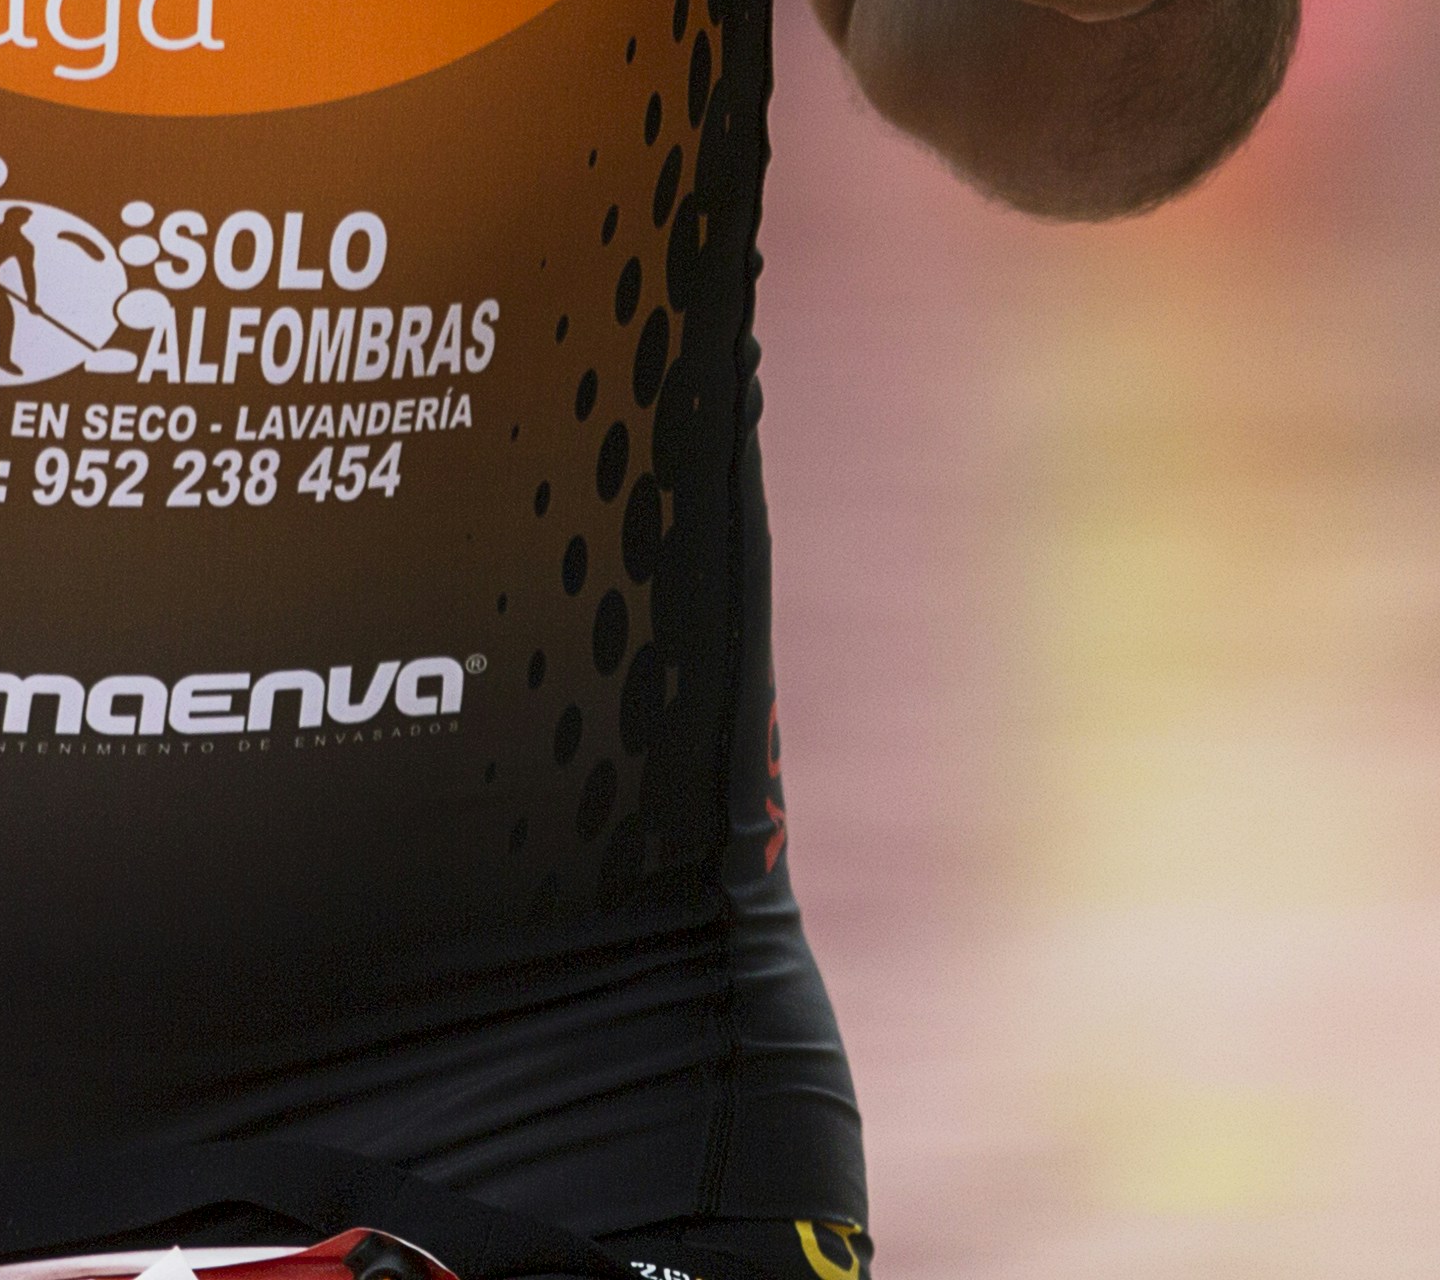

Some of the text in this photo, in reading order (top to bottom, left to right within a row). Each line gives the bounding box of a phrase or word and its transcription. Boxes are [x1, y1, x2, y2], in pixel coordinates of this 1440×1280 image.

[154, 209, 388, 291] SOLO
[137, 298, 500, 385] ALFOMBRAS
[11, 401, 70, 439] EN
[82, 404, 198, 442] SECO
[235, 387, 473, 442] LAVANDERÍA
[32, 446, 150, 508] 952
[166, 448, 281, 508] 238
[297, 441, 403, 503] 454
[238, 741, 271, 753] DE
